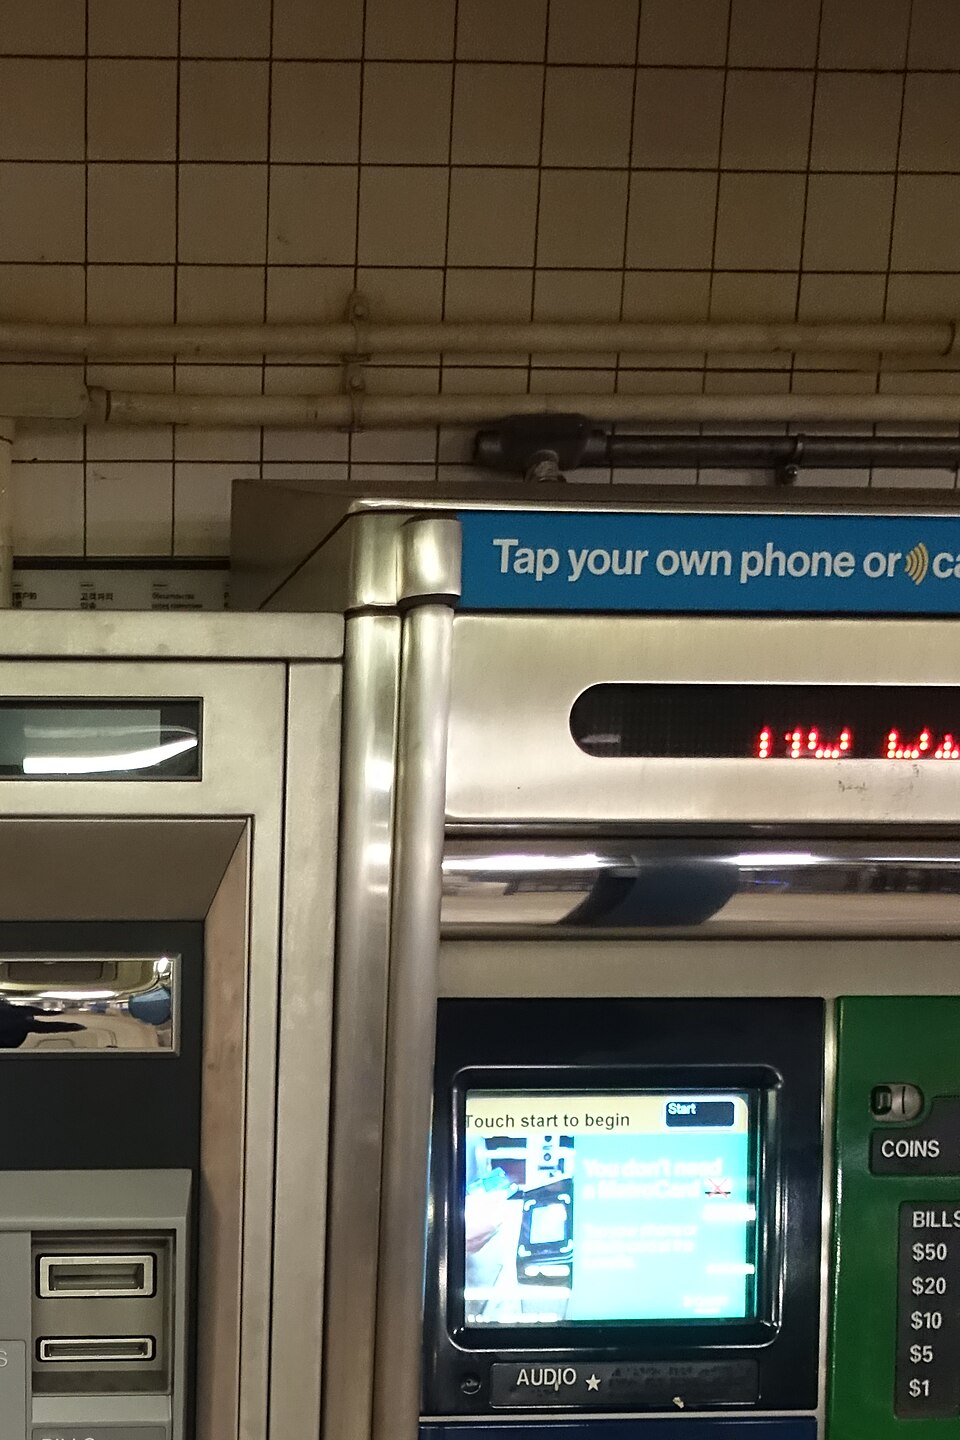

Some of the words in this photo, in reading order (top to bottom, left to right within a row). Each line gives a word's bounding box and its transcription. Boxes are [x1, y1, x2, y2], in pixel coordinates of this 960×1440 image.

[493, 539, 558, 581] Tap
[568, 548, 648, 582] your
[656, 549, 732, 576] own
[740, 542, 855, 584] phone
[862, 552, 902, 578] or
[668, 1102, 697, 1116] Start
[466, 1114, 515, 1129] Touch
[520, 1115, 558, 1128] start
[564, 1115, 579, 1128] to
[584, 1113, 630, 1131] begin
[881, 1139, 941, 1158] COINS
[912, 1210, 960, 1228] BILLS
[912, 1241, 947, 1262] $50
[912, 1276, 946, 1296] $20
[911, 1310, 942, 1330] $10
[910, 1344, 933, 1364] $5
[516, 1368, 576, 1387] AUDIO
[909, 1378, 931, 1398] $1
